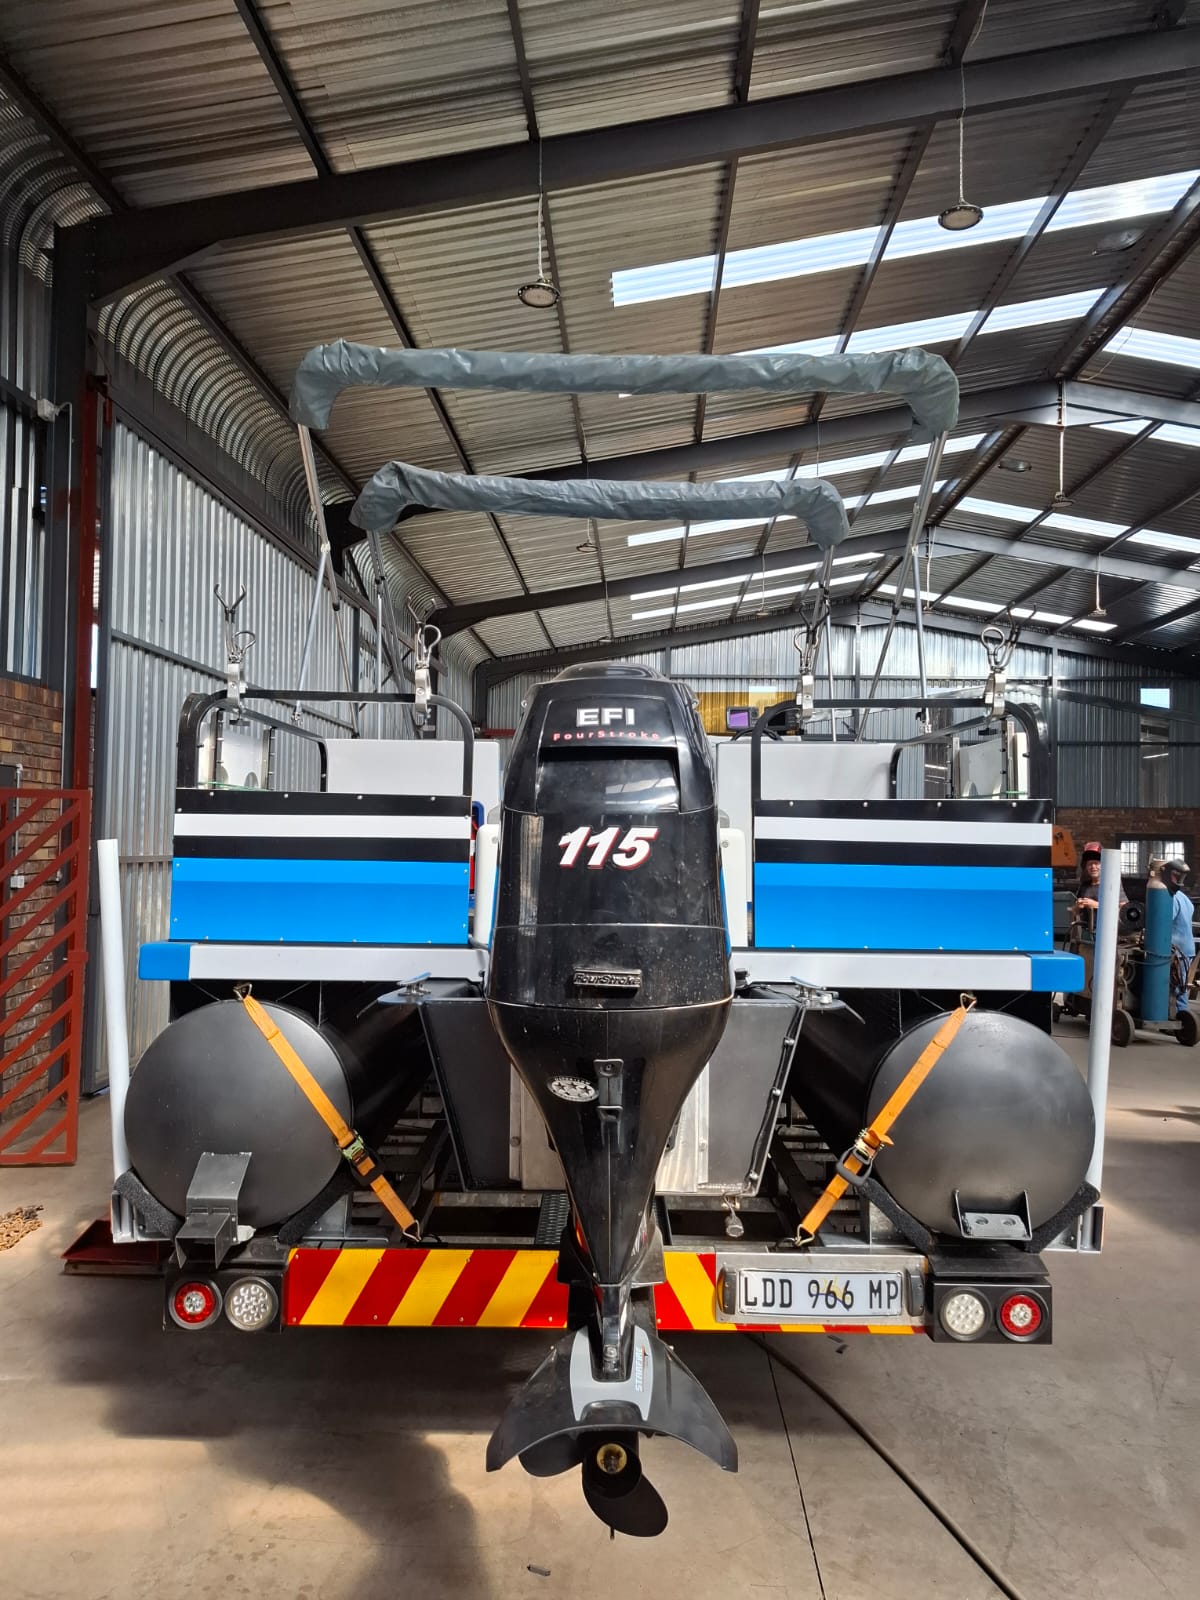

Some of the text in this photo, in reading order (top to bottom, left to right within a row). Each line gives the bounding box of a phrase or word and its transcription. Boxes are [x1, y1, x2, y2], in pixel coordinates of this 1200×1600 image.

[576, 708, 635, 727] EFI
[552, 730, 660, 741] FourStroke
[558, 826, 659, 870] 115
[574, 973, 640, 986] FourStroke
[744, 1276, 899, 1310] LDD 966 MP
